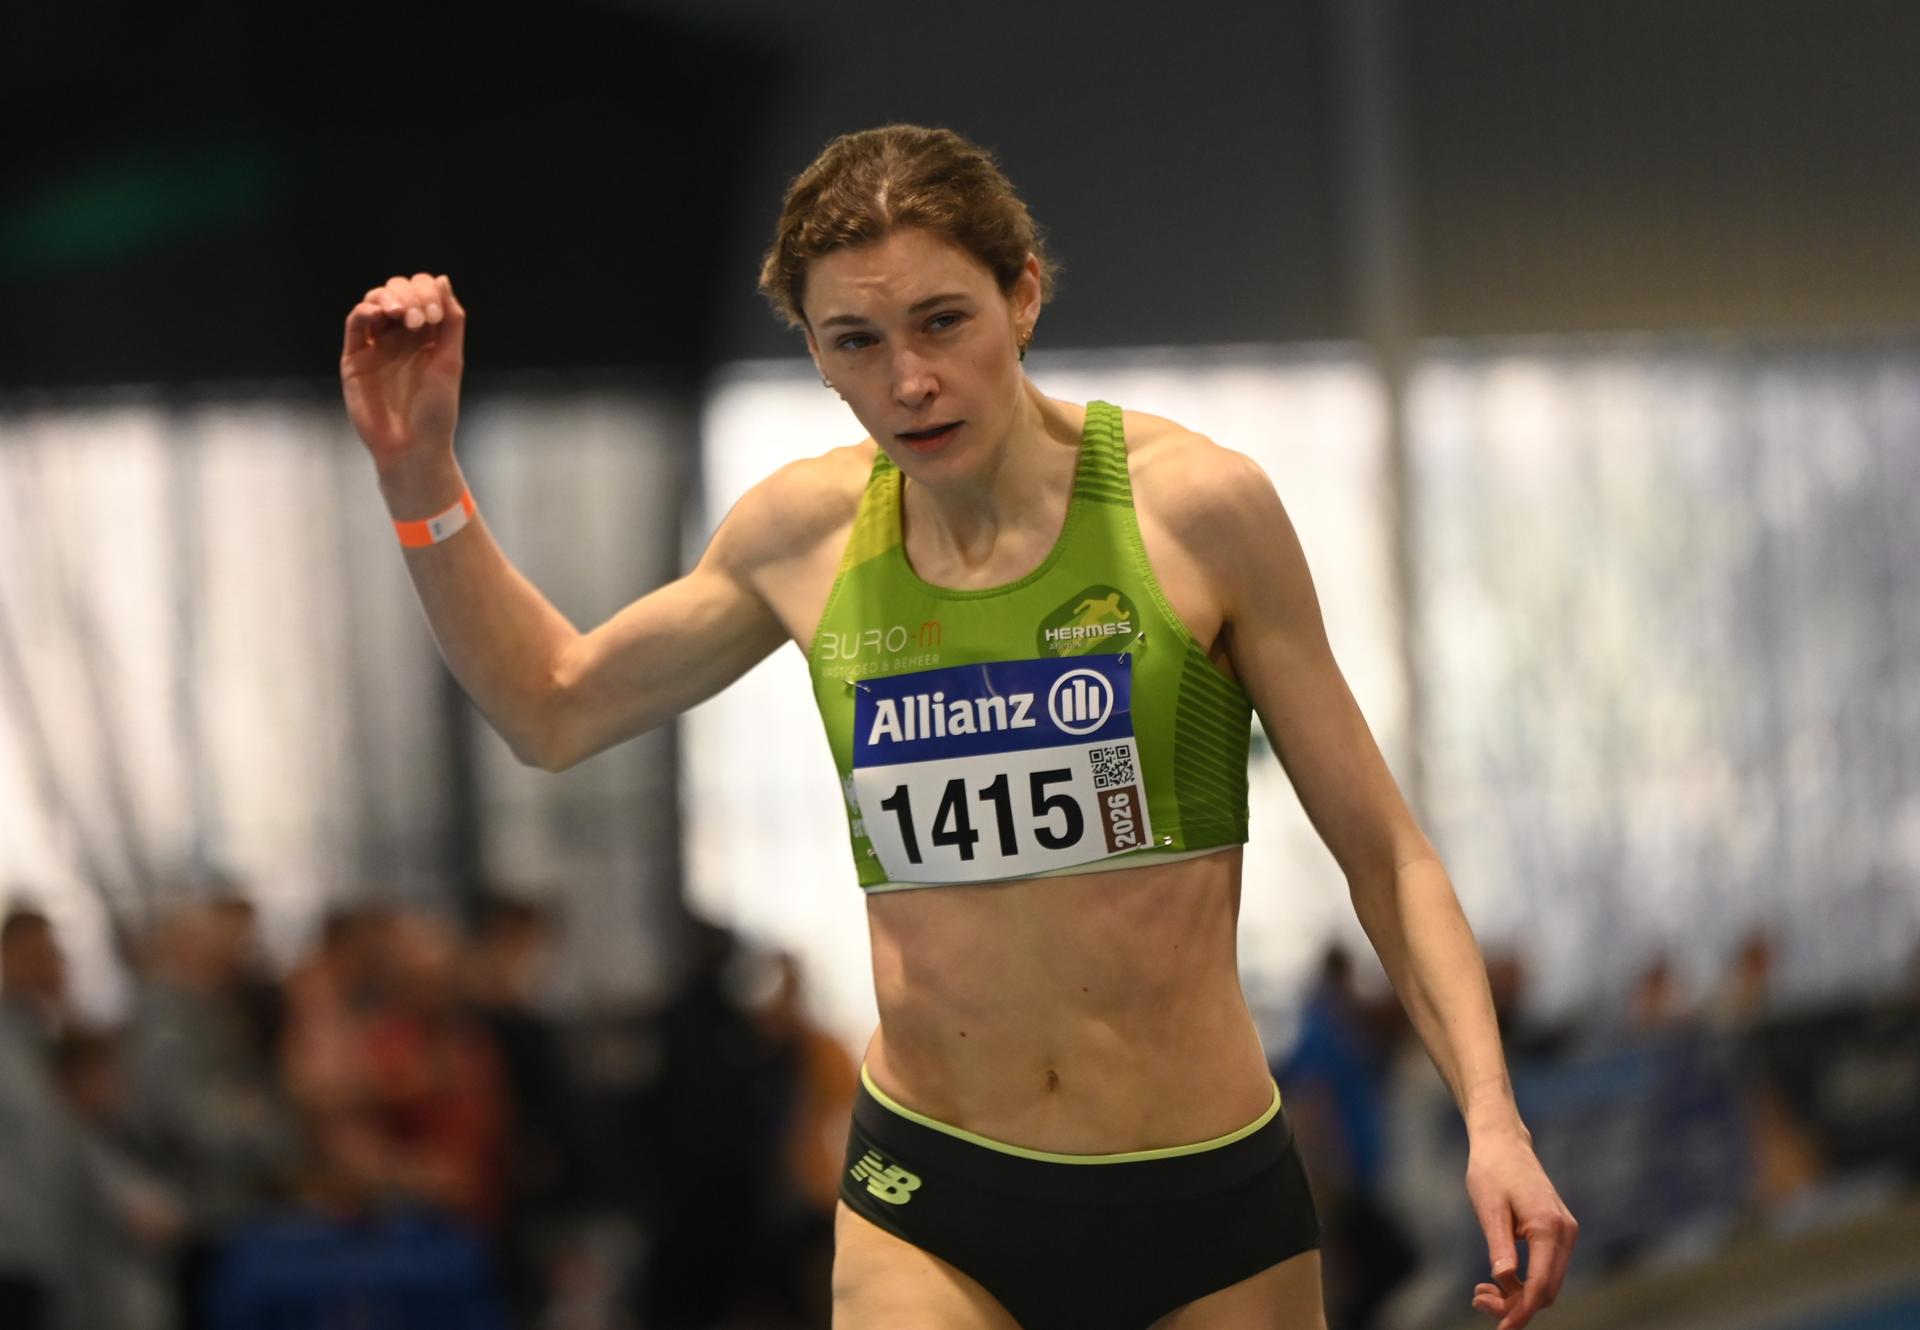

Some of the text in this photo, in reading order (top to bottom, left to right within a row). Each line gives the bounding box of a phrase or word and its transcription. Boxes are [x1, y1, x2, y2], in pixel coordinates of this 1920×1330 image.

[1045, 621, 1132, 641] HERMES
[893, 654, 940, 669] BEHEER
[868, 691, 1037, 745] Allianz
[881, 768, 1084, 864] 1415
[1107, 793, 1137, 848] 2026
